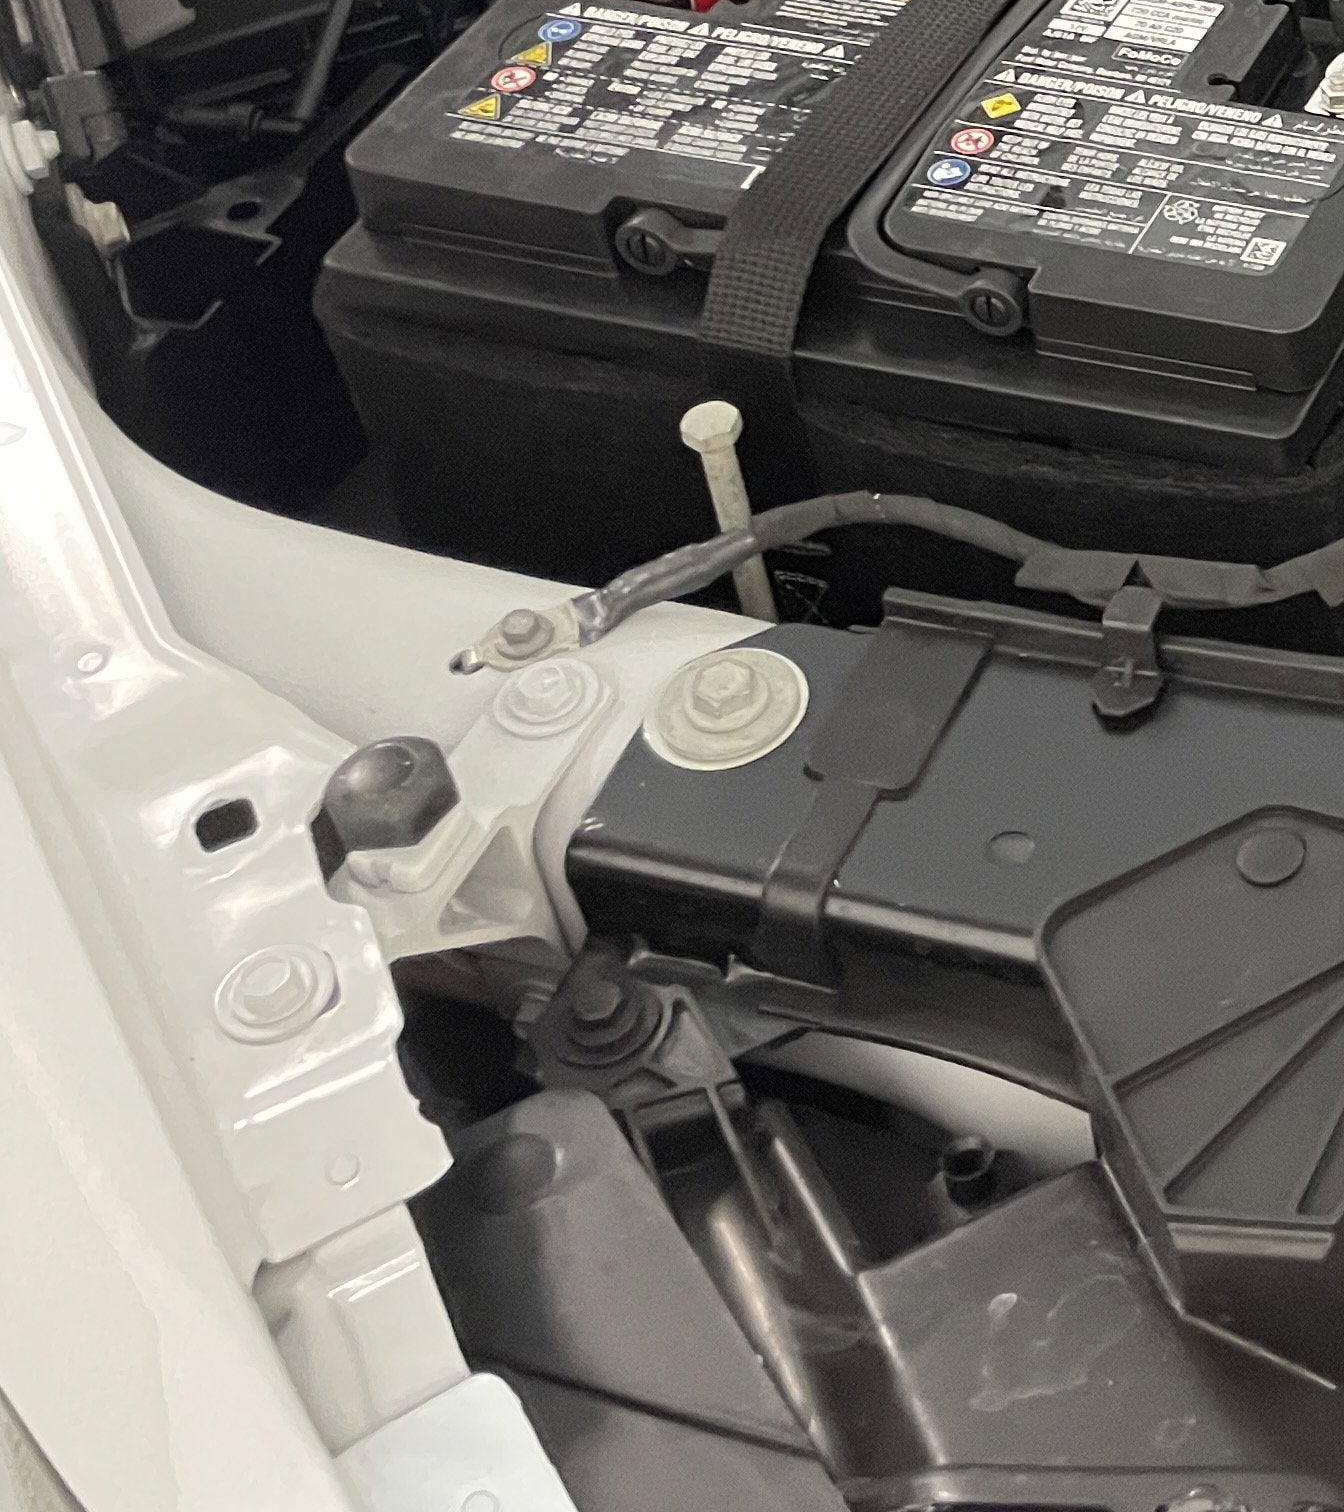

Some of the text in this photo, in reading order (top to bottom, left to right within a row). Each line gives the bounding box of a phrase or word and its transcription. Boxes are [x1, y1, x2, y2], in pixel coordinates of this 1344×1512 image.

[1117, 46, 1182, 66] FoMoCo
[1017, 72, 1263, 124] DANGER/POISON PELIGRO/VENENO
